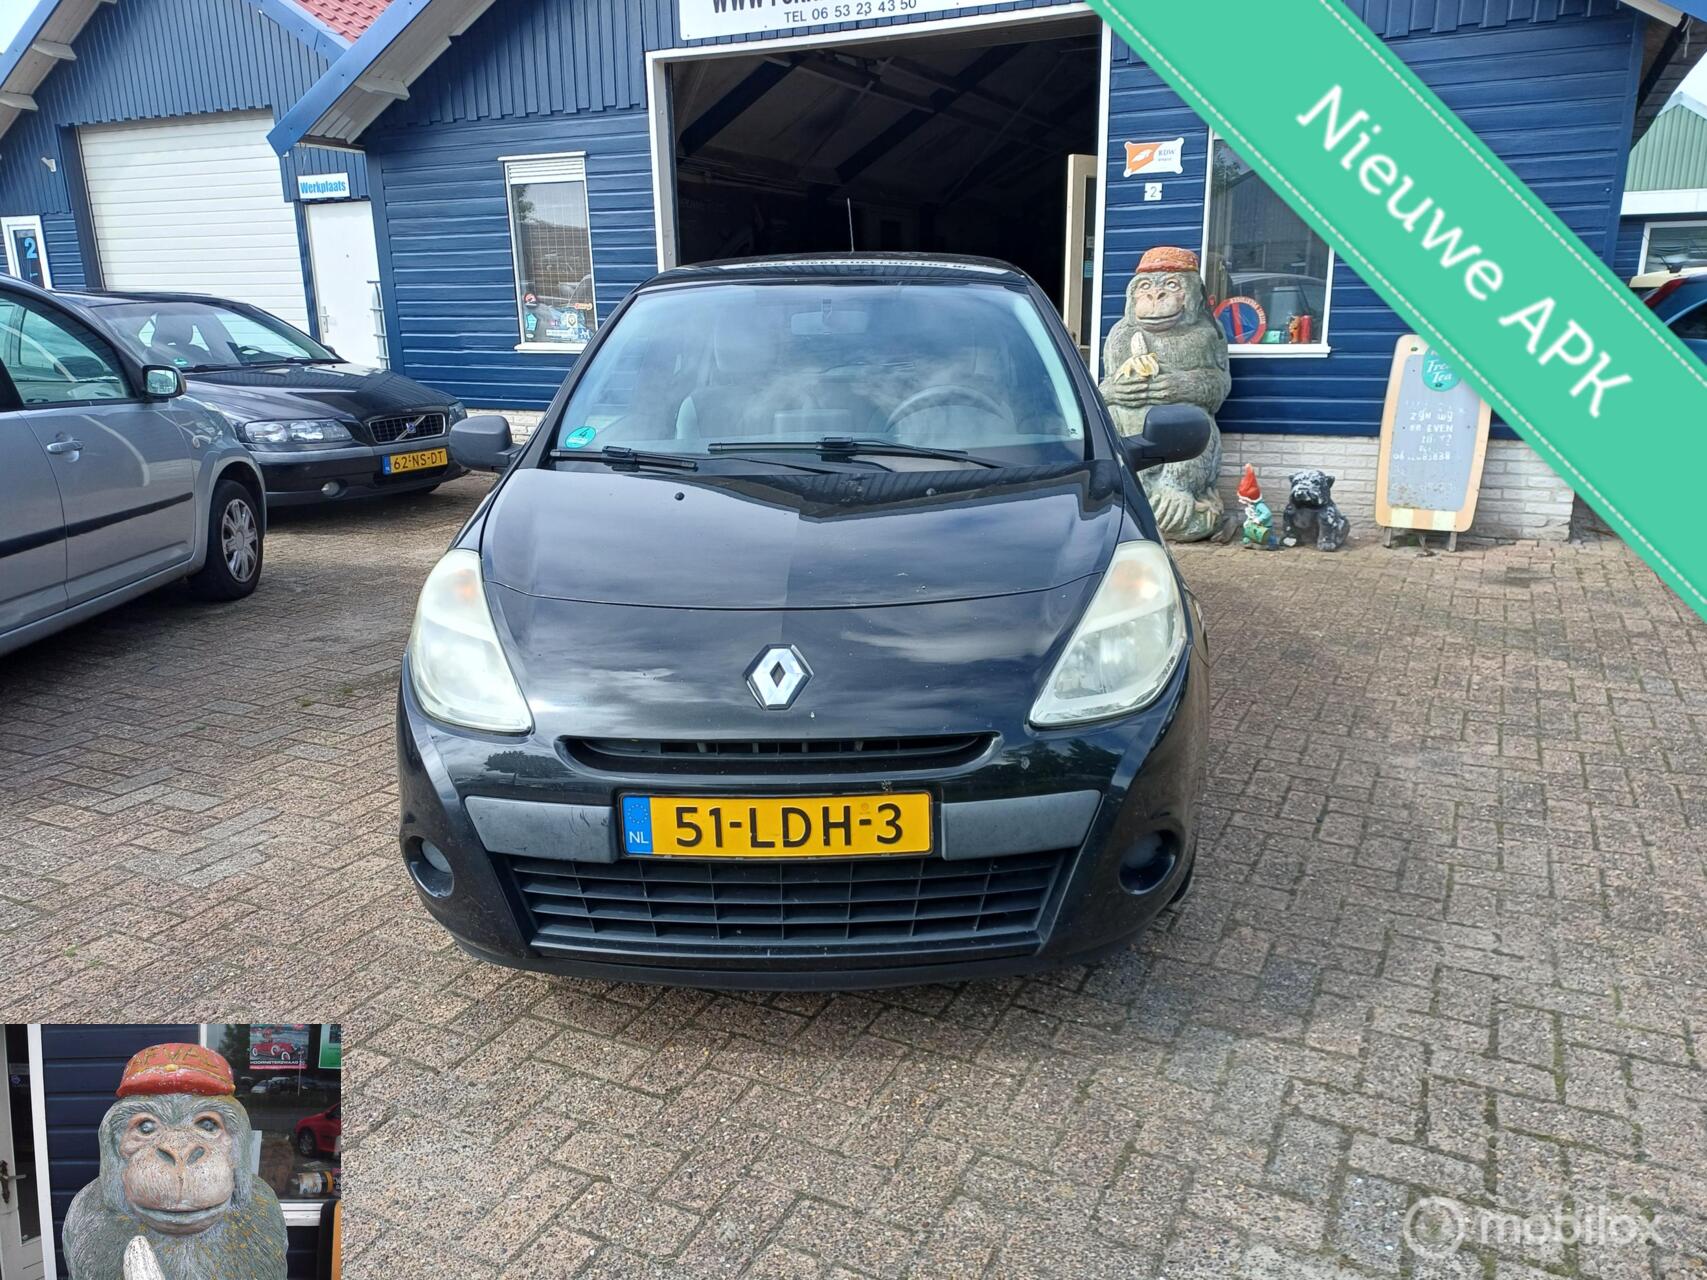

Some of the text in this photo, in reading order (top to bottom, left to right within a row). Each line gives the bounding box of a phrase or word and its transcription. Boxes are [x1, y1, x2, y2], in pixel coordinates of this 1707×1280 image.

[784, 11, 807, 23] TEL
[812, 7, 829, 20] 06
[834, 4, 850, 18] 53
[856, 2, 872, 15] 23
[878, 0, 896, 13] 43
[900, 0, 917, 10] 50
[299, 180, 347, 194] Werkplaats
[1150, 186, 1158, 198] 2
[24, 237, 38, 259] 2
[1426, 424, 1453, 432] EVEN
[393, 451, 443, 470] 62-NS-DT
[629, 803, 903, 848] NL 51-LDH-3
